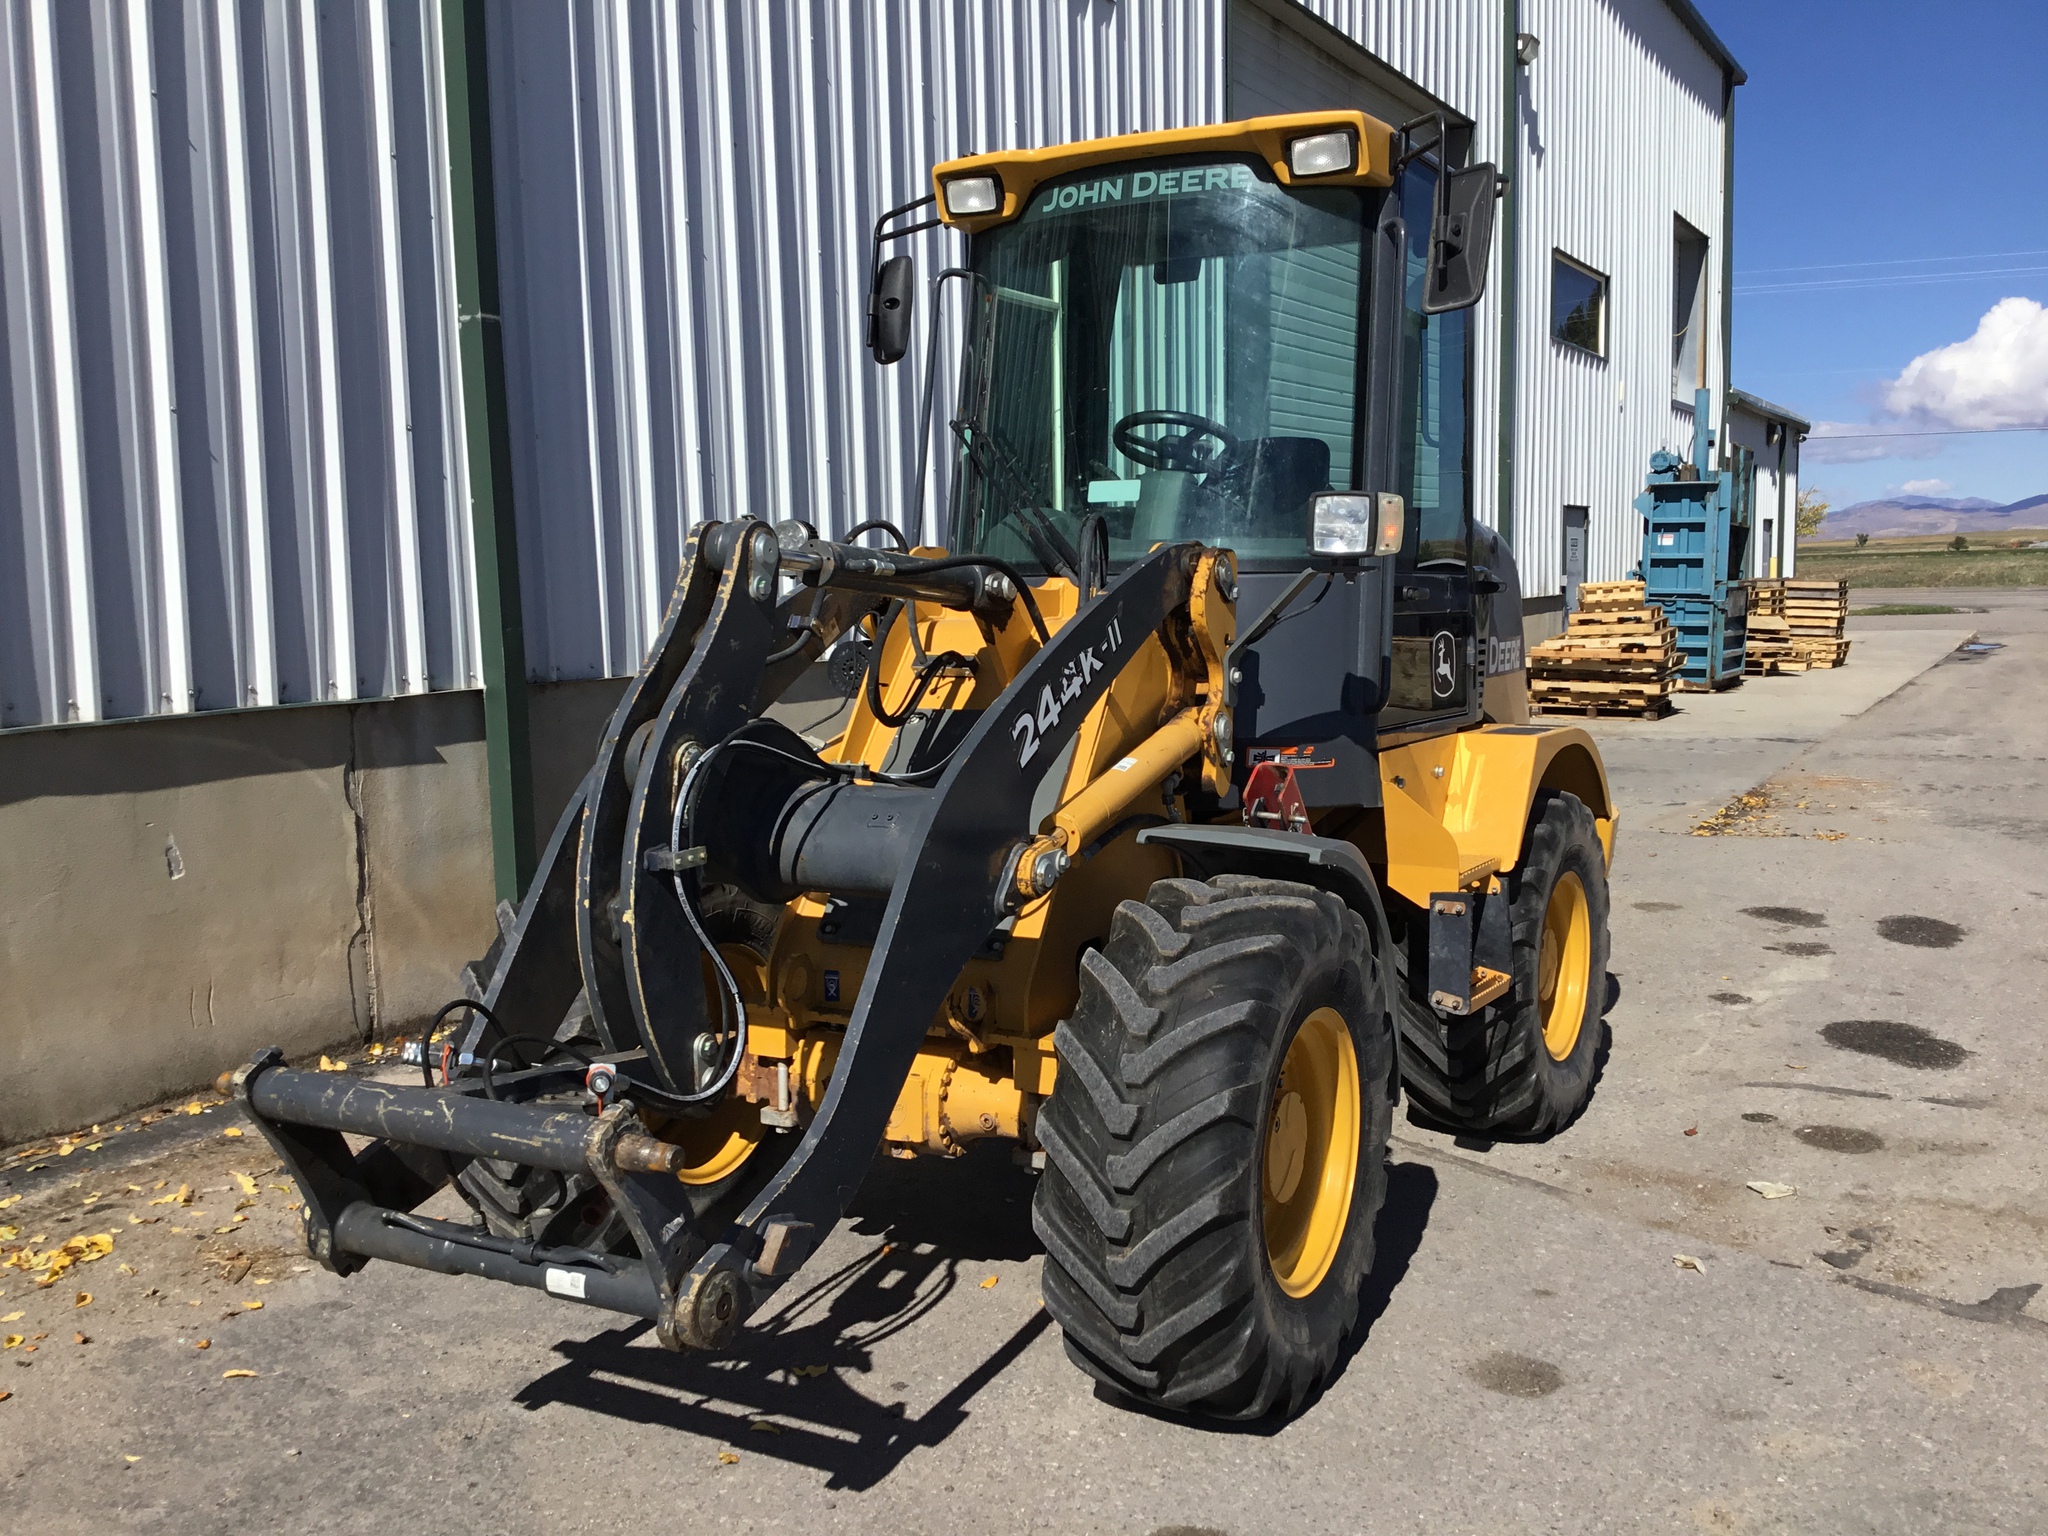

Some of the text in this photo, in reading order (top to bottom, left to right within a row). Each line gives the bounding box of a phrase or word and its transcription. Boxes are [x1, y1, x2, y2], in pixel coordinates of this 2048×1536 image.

[1042, 165, 1253, 213] JOHN DEERE
[1489, 636, 1521, 674] DEERE
